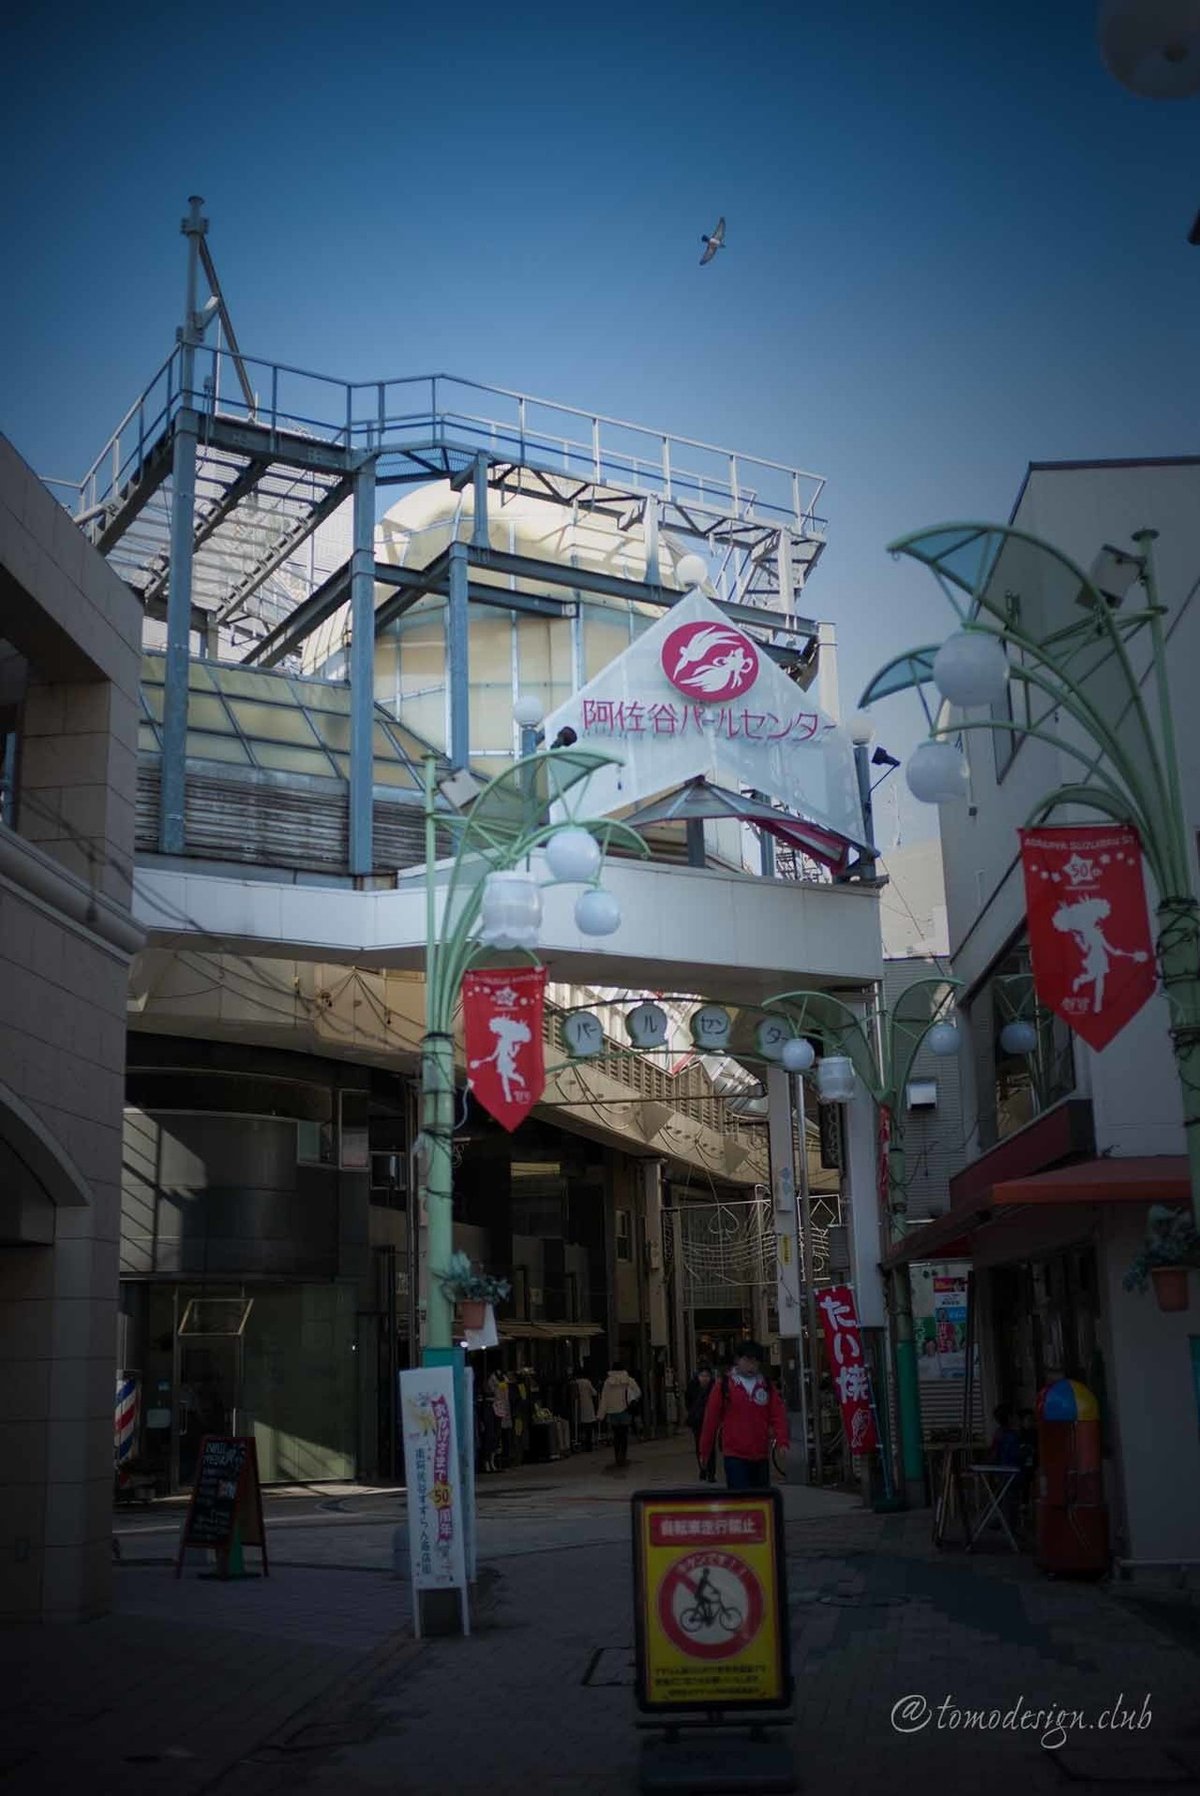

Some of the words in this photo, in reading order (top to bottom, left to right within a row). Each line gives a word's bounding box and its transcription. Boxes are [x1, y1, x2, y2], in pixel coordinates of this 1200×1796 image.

[583, 700, 836, 741] 阿佐谷パールセンター
